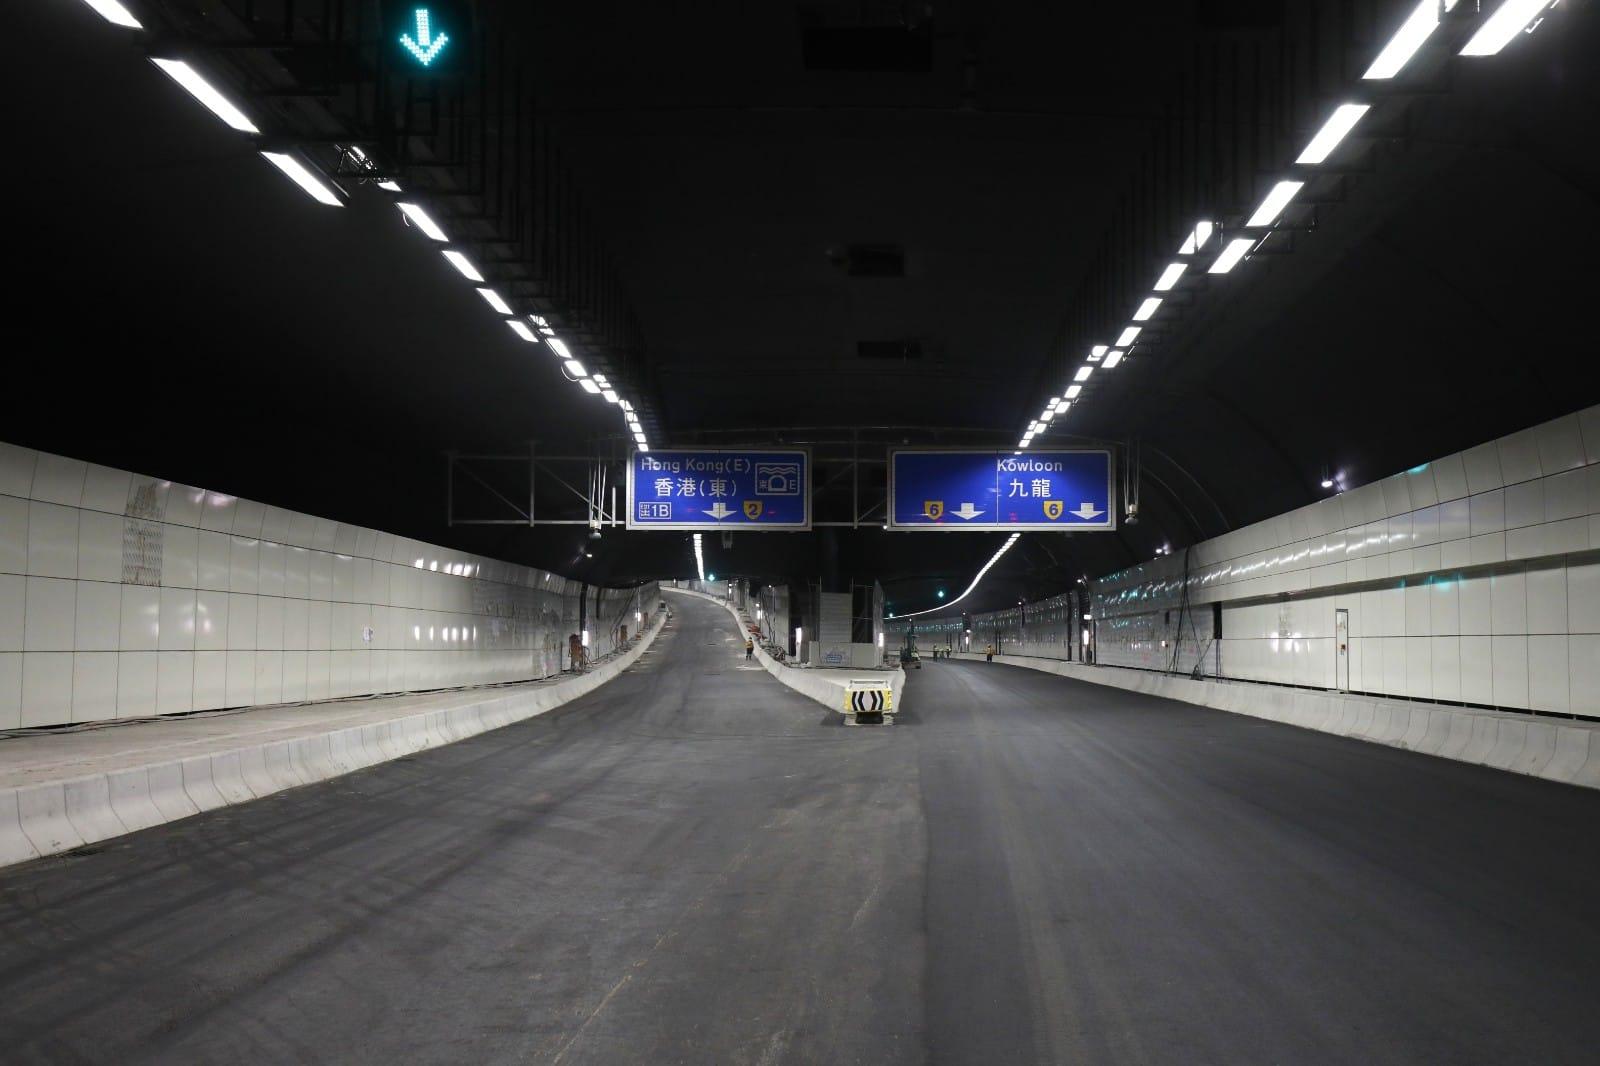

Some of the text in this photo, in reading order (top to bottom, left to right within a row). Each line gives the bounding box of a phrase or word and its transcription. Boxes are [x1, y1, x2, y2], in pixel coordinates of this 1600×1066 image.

[641, 458, 751, 474] Hong Kong(E)
[997, 459, 1063, 472] Kowloon
[789, 479, 797, 490] E
[1008, 478, 1052, 498] 九龍
[652, 504, 669, 517] 1B
[748, 503, 758, 516] 2
[929, 503, 939, 516] 6
[1048, 503, 1058, 516] 6
